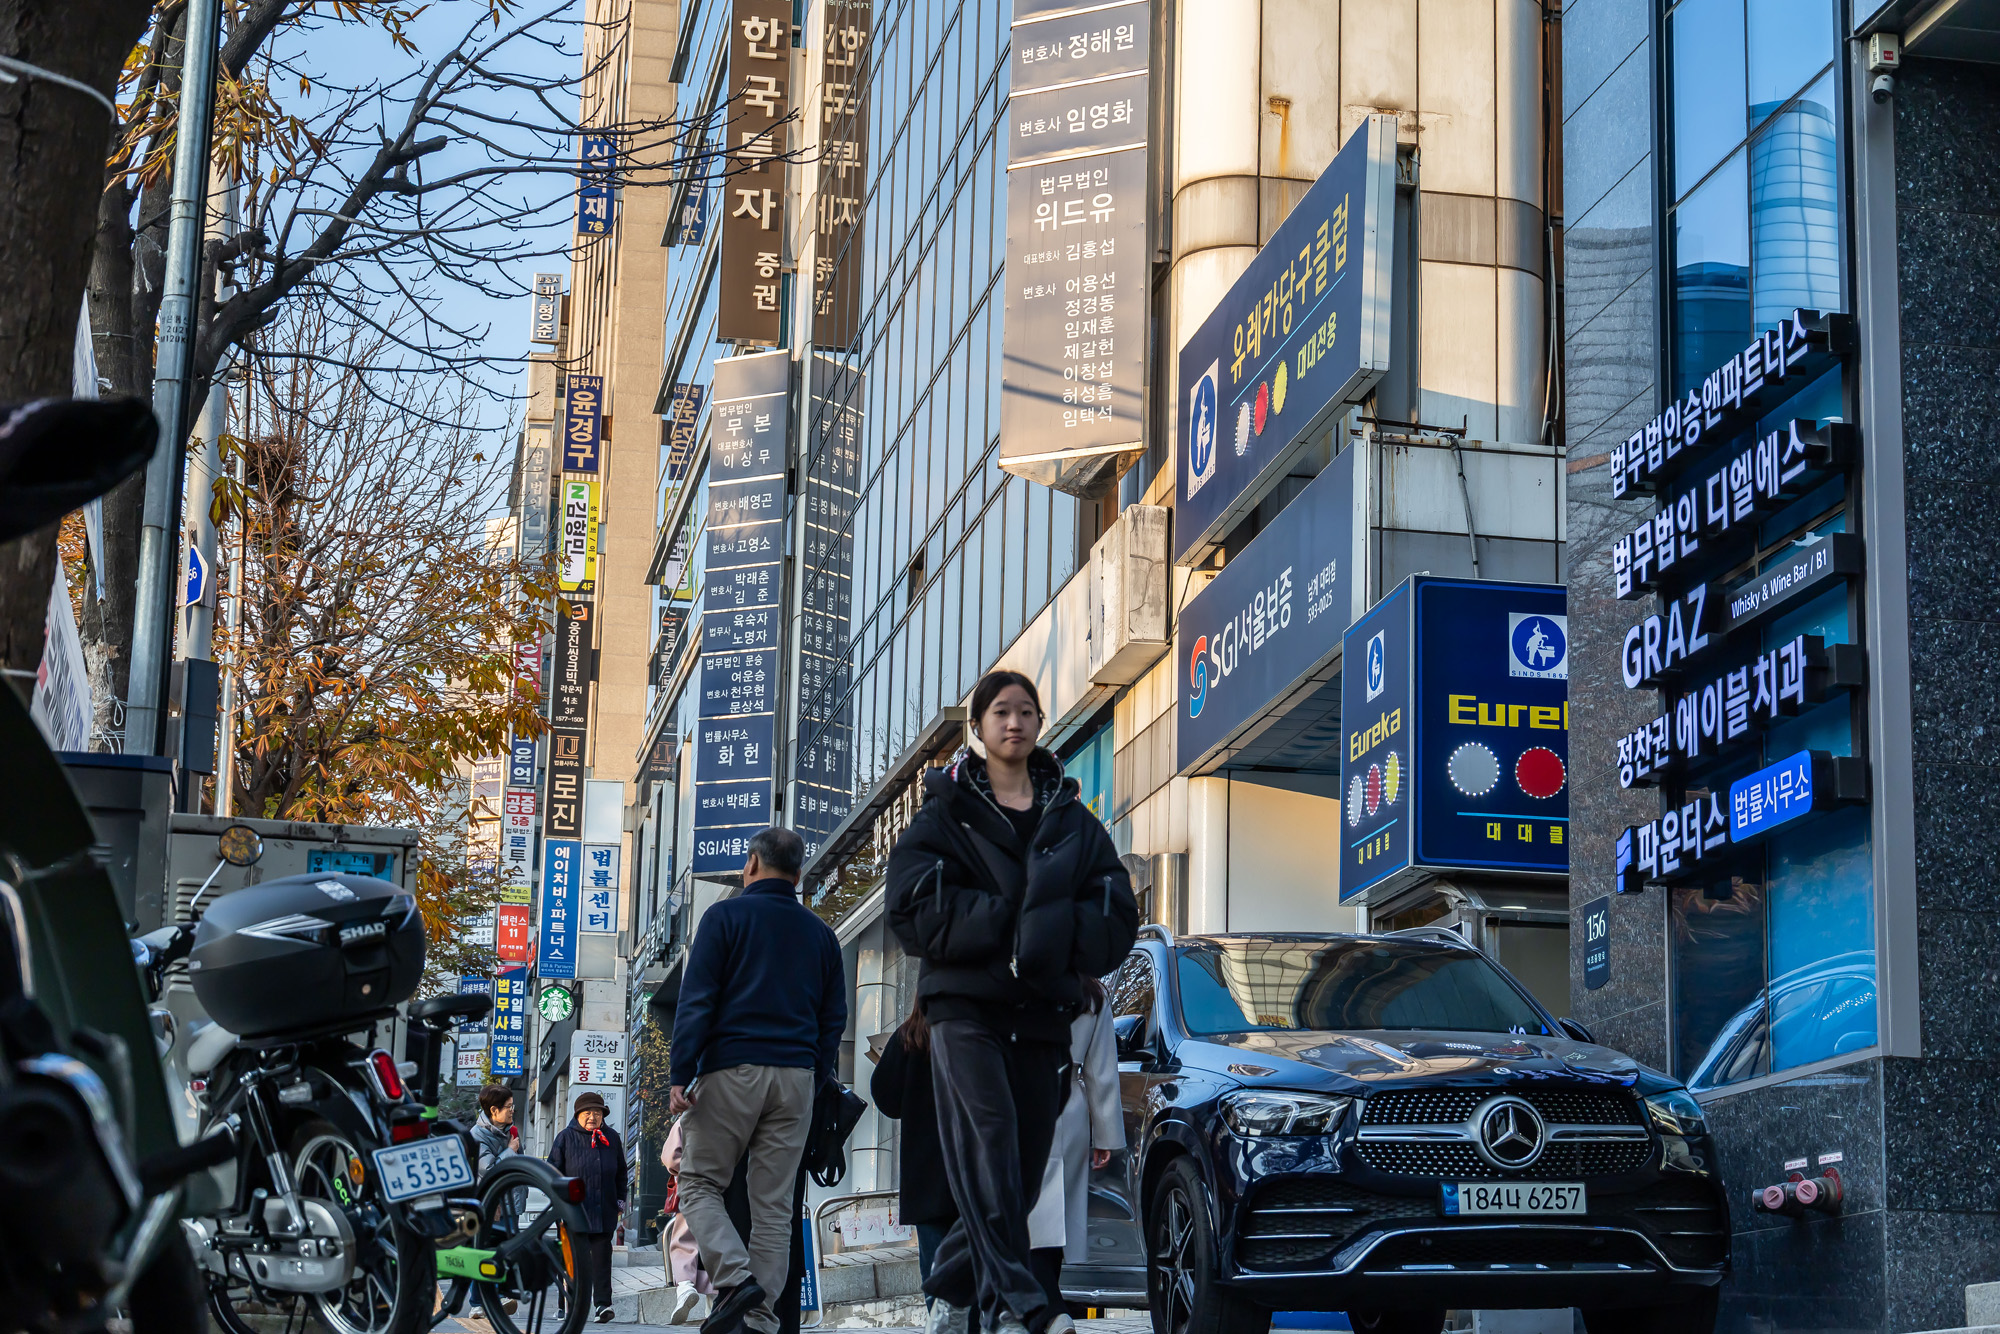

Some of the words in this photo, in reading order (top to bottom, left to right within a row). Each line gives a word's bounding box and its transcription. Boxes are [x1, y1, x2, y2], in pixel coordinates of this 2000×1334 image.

[1021, 42, 1063, 64] 변호사
[1068, 24, 1134, 59] 정해원
[732, 16, 784, 230] 한국투자
[1020, 116, 1061, 137] 변호사
[1066, 99, 1134, 133] 임영화
[1040, 168, 1108, 195] 법무법인
[1034, 193, 1115, 231] 위드유
[587, 221, 605, 232] 7층
[1023, 250, 1060, 264] 대표변호사
[1065, 238, 1115, 261] 김홍섭
[753, 252, 781, 311] 증권
[1023, 283, 1056, 299] 변호사
[1065, 272, 1115, 294] 어용선
[1230, 192, 1349, 384] 유레카당구클럽
[536, 285, 557, 340] 박형준
[1065, 294, 1115, 316] 정경동
[1065, 316, 1114, 338] 임재훈
[1064, 338, 1114, 360] 제갈헌
[1296, 311, 1337, 380] 대대전용
[1064, 360, 1113, 382] 이창섭
[570, 377, 600, 390] 법무사
[1063, 382, 1113, 404] 허성흠
[718, 402, 753, 416] 법무법인
[1610, 308, 1809, 500] 법무법인승앤파트너스
[1063, 405, 1113, 427] 임택석
[567, 391, 597, 468] 윤경구
[714, 500, 736, 511] 변호사
[1613, 487, 1699, 600] 법무법인
[1706, 418, 1806, 530] 디엘에스
[565, 501, 586, 554] 김형민
[712, 543, 734, 554] 변호사
[736, 536, 771, 553] 고영소
[735, 570, 770, 586] 박래춘
[1320, 558, 1336, 590] 대리점
[1731, 591, 1760, 619] Whisky
[1762, 584, 1769, 601] &
[1770, 573, 1792, 596] Wine
[1793, 563, 1808, 583] Bar
[1816, 548, 1827, 569] B1
[581, 582, 594, 591] 4F
[710, 585, 732, 596] 변호사
[1307, 589, 1333, 624] 593-0025
[733, 612, 768, 628] 육숙자
[1211, 565, 1293, 689] SGI서울보증
[709, 627, 731, 637] 법무사
[732, 629, 767, 645] 노명자
[1622, 582, 1709, 689] GRAZ
[566, 621, 581, 685] 웅진씽크빅
[706, 656, 741, 670] 법무법인
[745, 653, 763, 667] 문승
[1511, 669, 1542, 678] SINDS
[1547, 672, 1568, 680] 1897
[560, 685, 582, 694] 라운지
[562, 697, 578, 705] 서초
[707, 688, 728, 699] 변호사
[730, 683, 765, 699] 천우현
[564, 707, 576, 715] 3F
[729, 699, 764, 714] 문상석
[1448, 694, 1568, 730] Eure
[1616, 712, 1671, 789] 정찬권
[1676, 634, 1807, 758] 에이블치과
[555, 715, 584, 723] 1577-1500
[705, 729, 749, 743] 법률사무소
[1350, 707, 1400, 763] Eureka
[507, 795, 535, 813] 공증
[552, 774, 577, 830] 로진
[702, 798, 724, 809] 변호사
[726, 792, 761, 809] 박태호
[511, 816, 530, 826] 5층
[1637, 793, 1726, 879] 파운더스
[1734, 765, 1810, 829] 법률사무소
[509, 836, 527, 877] 로투스
[587, 850, 613, 930] 법률센터
[339, 922, 386, 941] SHAD
[500, 915, 527, 926] 밸런스
[1586, 910, 1606, 943] 156
[509, 928, 518, 937] 11
[495, 979, 511, 1030] 법무사
[510, 980, 524, 1030] 김일동
[497, 1046, 519, 1057] 밀알
[496, 1058, 518, 1069] 녹취
[578, 1058, 590, 1082] 도장
[595, 1060, 607, 1083] 문구
[612, 1060, 625, 1083] 인쇄
[406, 1155, 464, 1188] 5355
[1462, 1187, 1521, 1210] 184나
[1527, 1187, 1580, 1210] 6257
